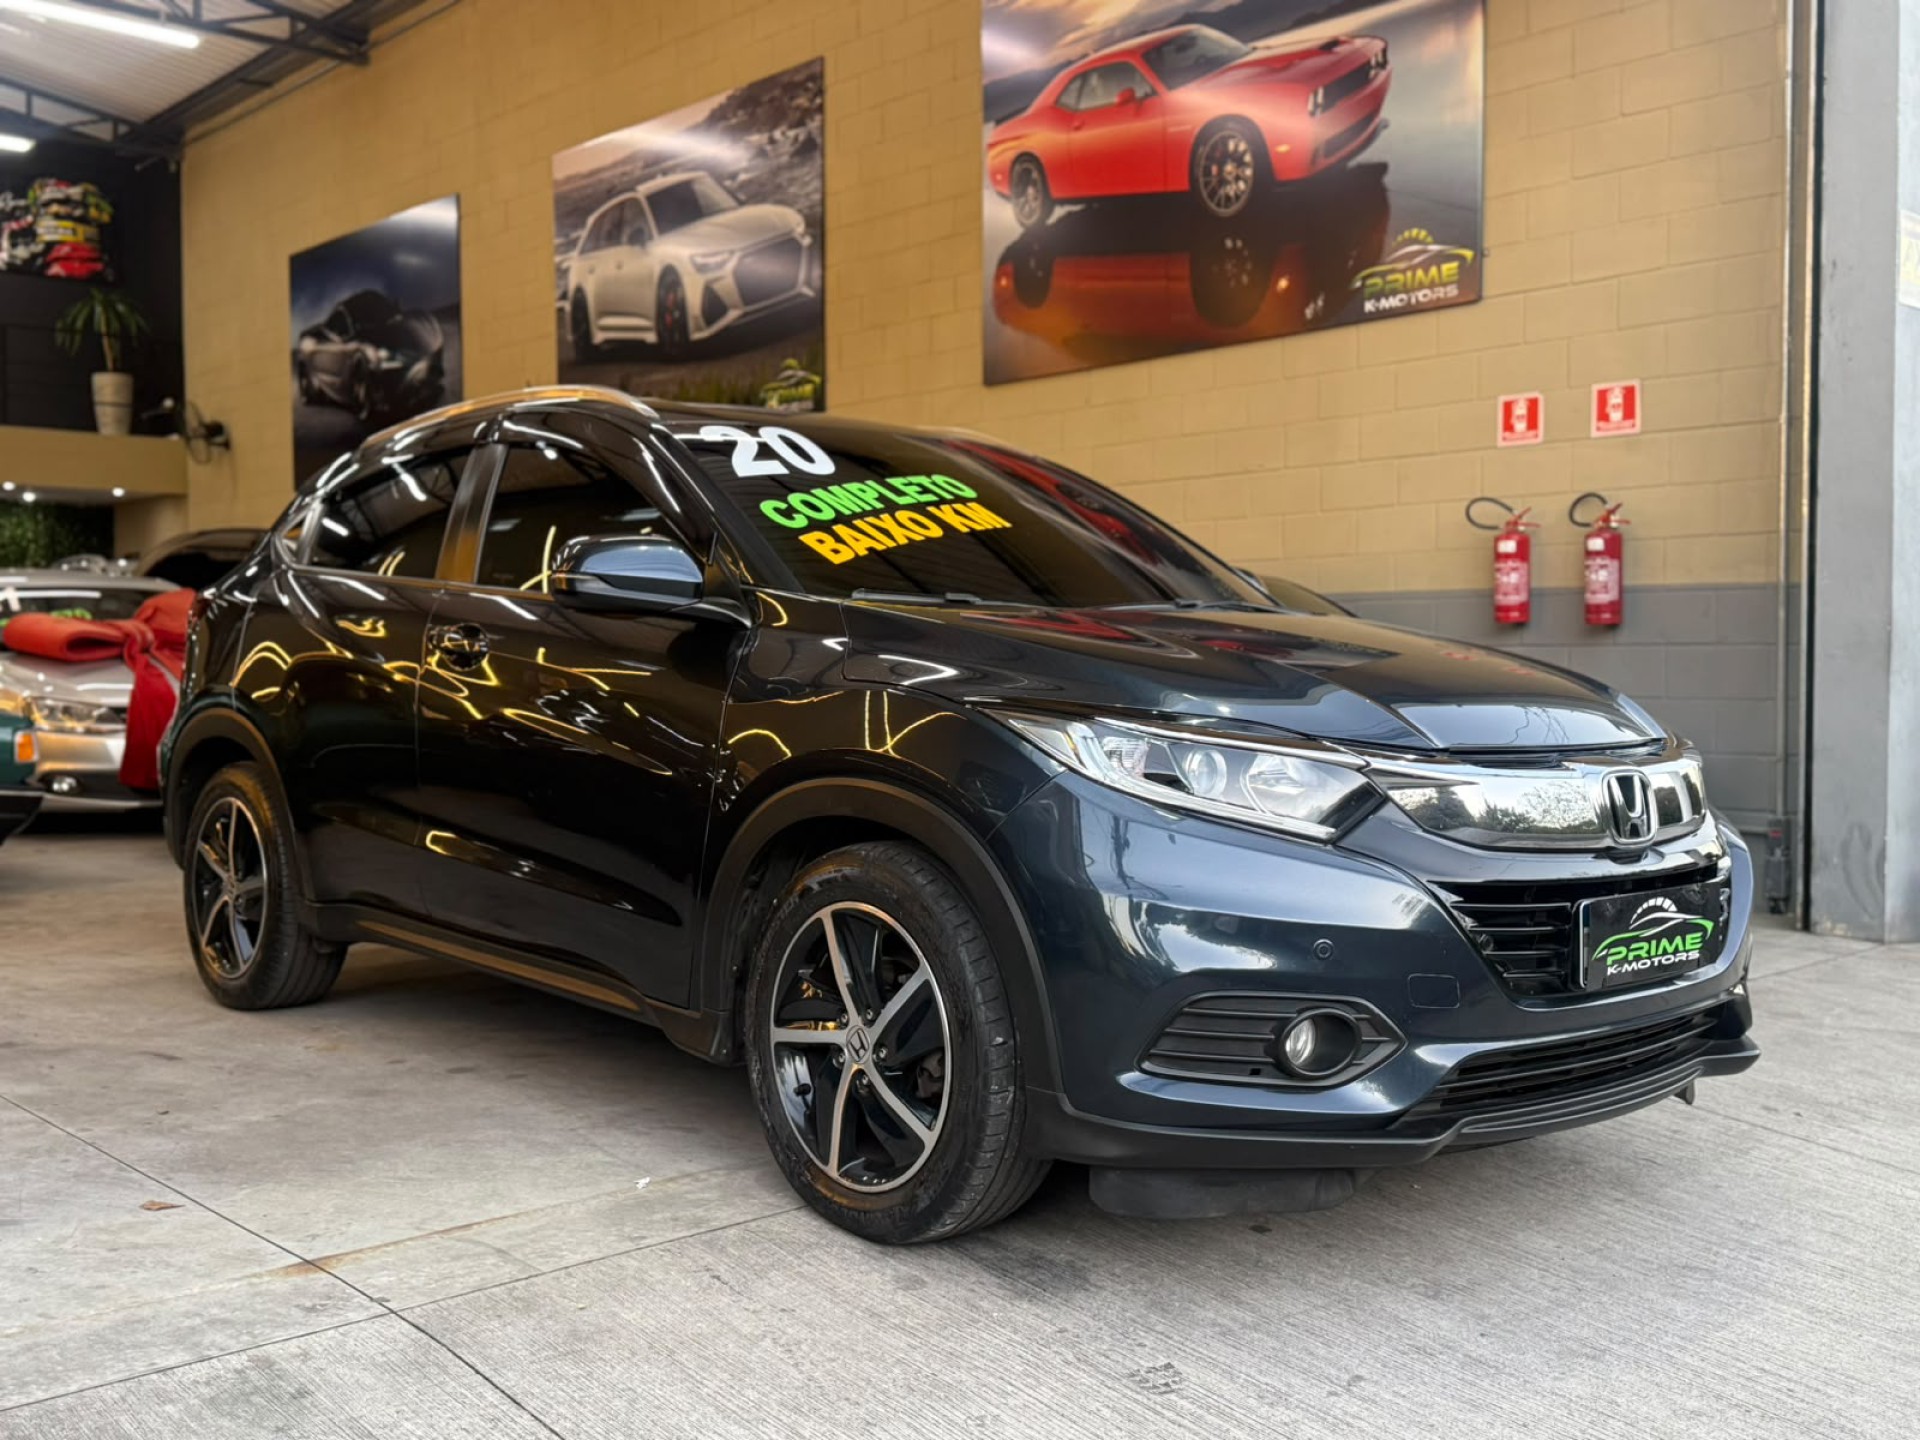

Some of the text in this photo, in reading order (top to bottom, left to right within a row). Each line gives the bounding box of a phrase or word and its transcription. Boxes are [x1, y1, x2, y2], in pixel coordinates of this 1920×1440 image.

[1364, 261, 1460, 297] PRIME
[1364, 284, 1459, 313] K-MOTORS
[700, 426, 836, 478] 20
[760, 475, 977, 528] COMPLETO
[799, 502, 1012, 564] BAIXO KM
[1607, 932, 1703, 965] PRIME
[1607, 951, 1700, 976] K-MOTORS
